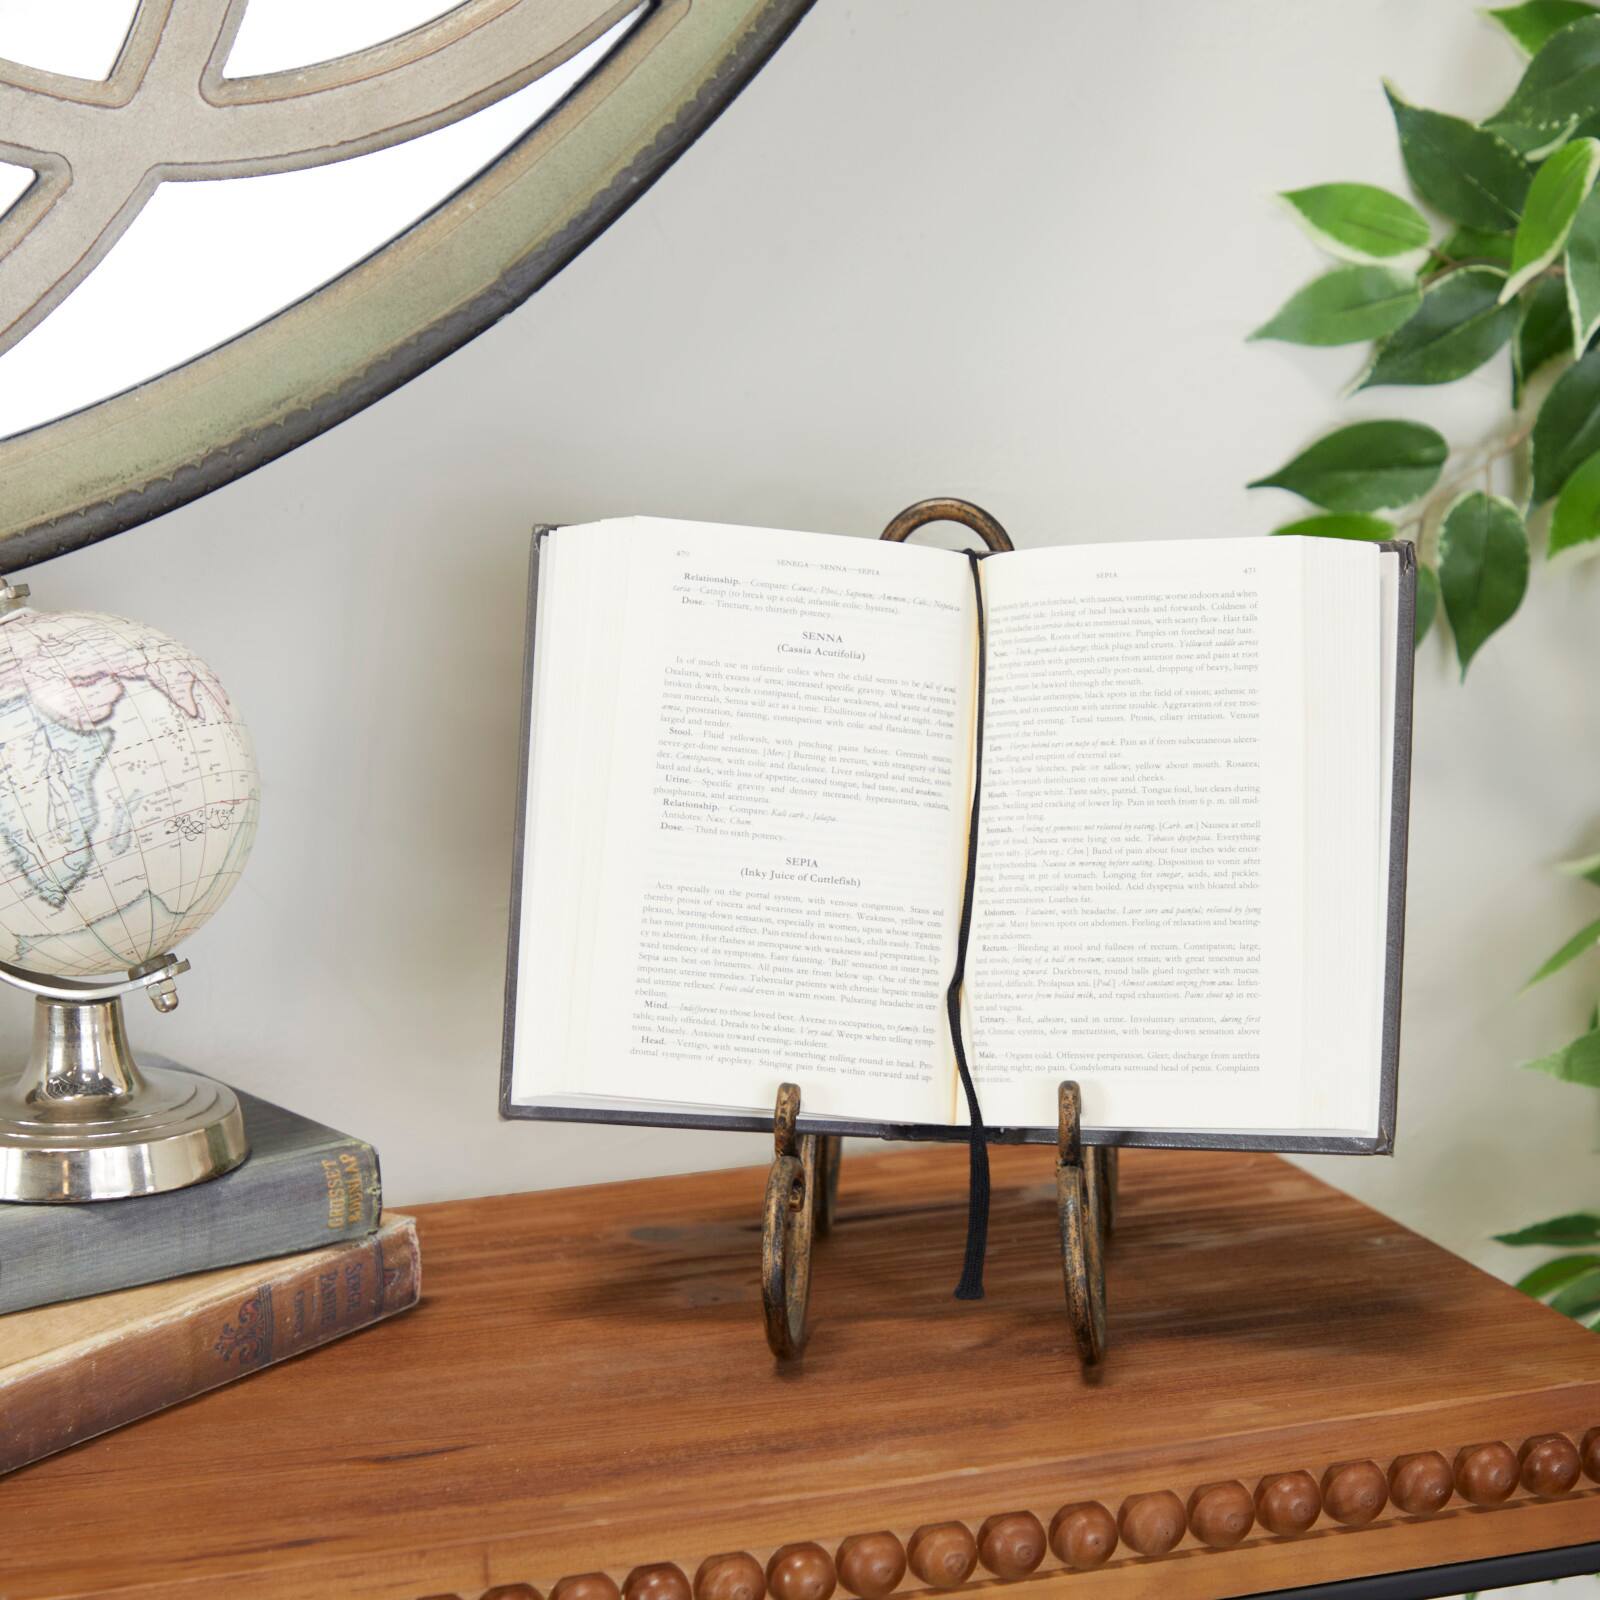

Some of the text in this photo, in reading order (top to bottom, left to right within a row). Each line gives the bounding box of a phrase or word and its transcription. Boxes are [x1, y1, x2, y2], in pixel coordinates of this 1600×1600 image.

[802, 630, 842, 643] SENNA
[776, 642, 865, 662] (Cassia Acutifolia)
[786, 855, 818, 868] SEPIA
[740, 866, 860, 889] (Inky Juice of Cuttlefish)
[322, 1159, 344, 1231] GROSSET
